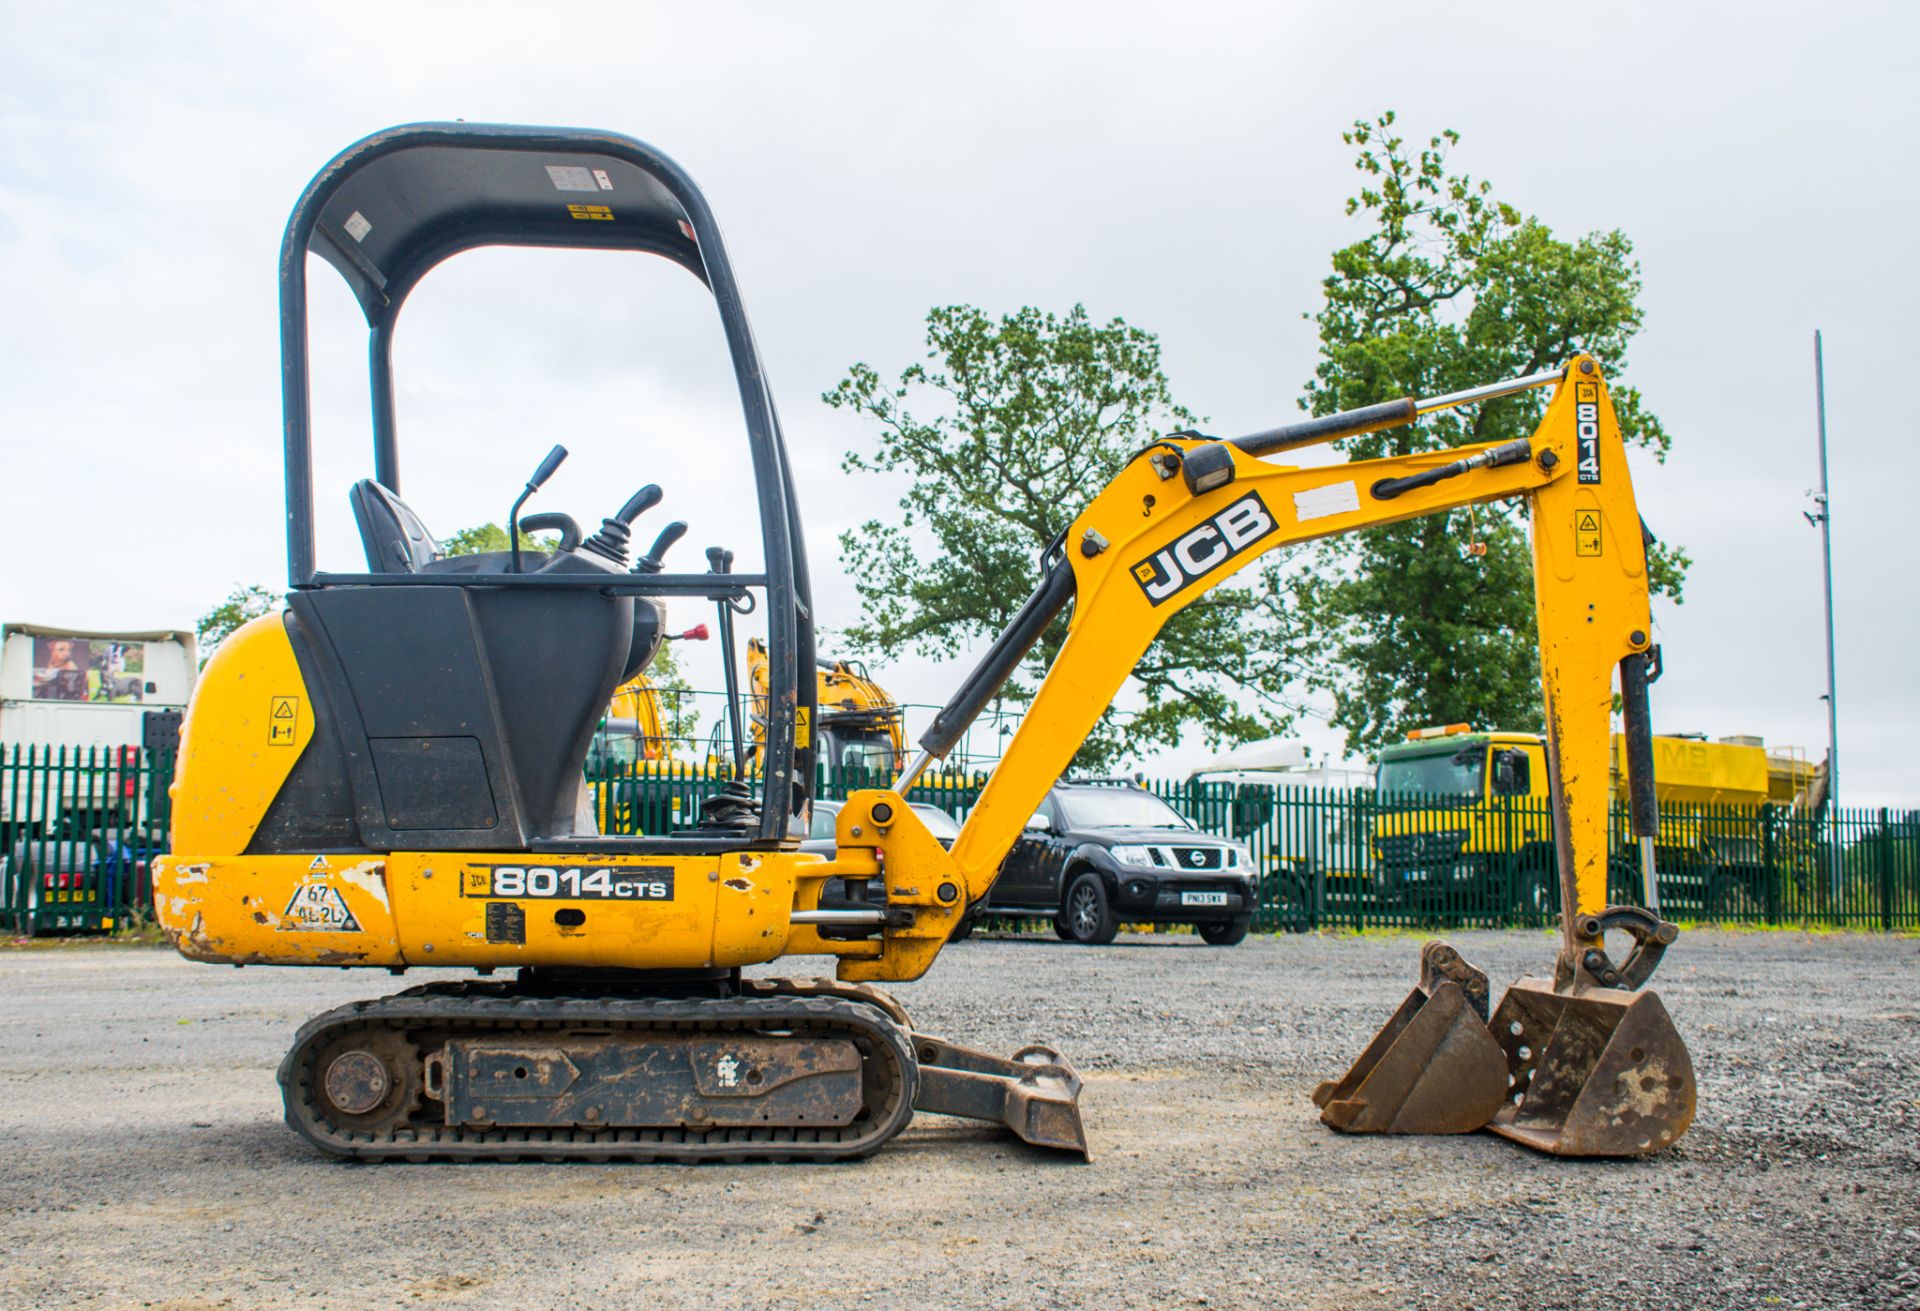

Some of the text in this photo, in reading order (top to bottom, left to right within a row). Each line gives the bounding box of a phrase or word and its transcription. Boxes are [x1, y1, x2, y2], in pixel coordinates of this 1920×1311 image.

[1577, 404, 1599, 474] 8014
[1146, 498, 1272, 600] JCB
[307, 886, 328, 902] 67
[494, 867, 614, 897] 8014
[614, 882, 667, 898] CTS
